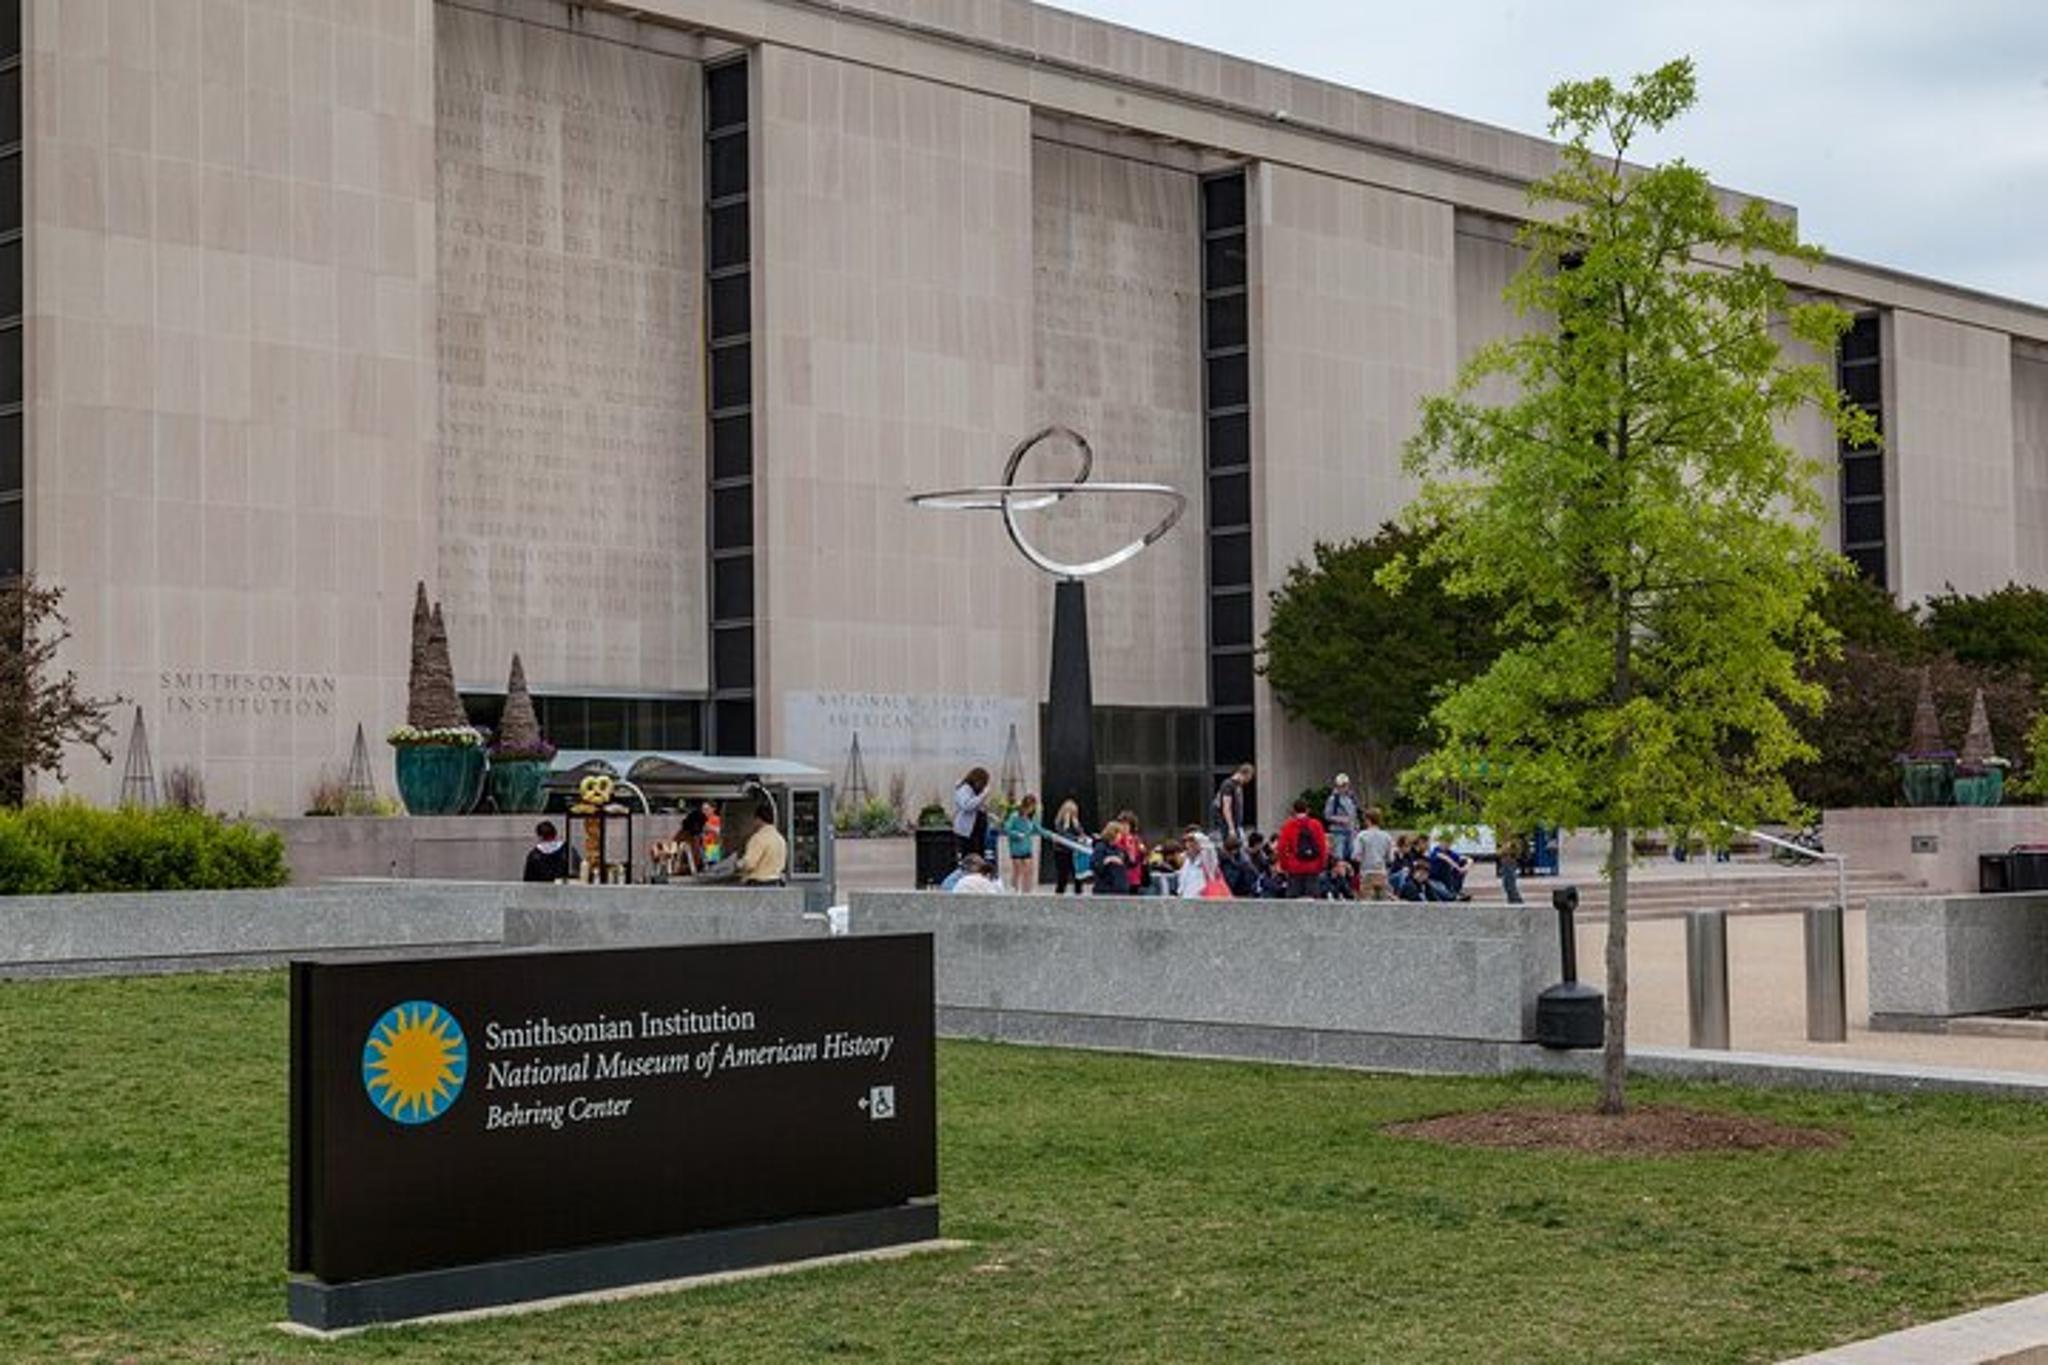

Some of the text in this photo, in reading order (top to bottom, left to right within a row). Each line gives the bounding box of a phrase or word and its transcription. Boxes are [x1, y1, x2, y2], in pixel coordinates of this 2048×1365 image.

[160, 673, 335, 692] SMITHSONIAN
[167, 696, 328, 715] INSTITUTION
[485, 1006, 755, 1050] Smithsonian Institution
[485, 1032, 894, 1090] National Museum of American History
[485, 1097, 632, 1130] Behring Center
